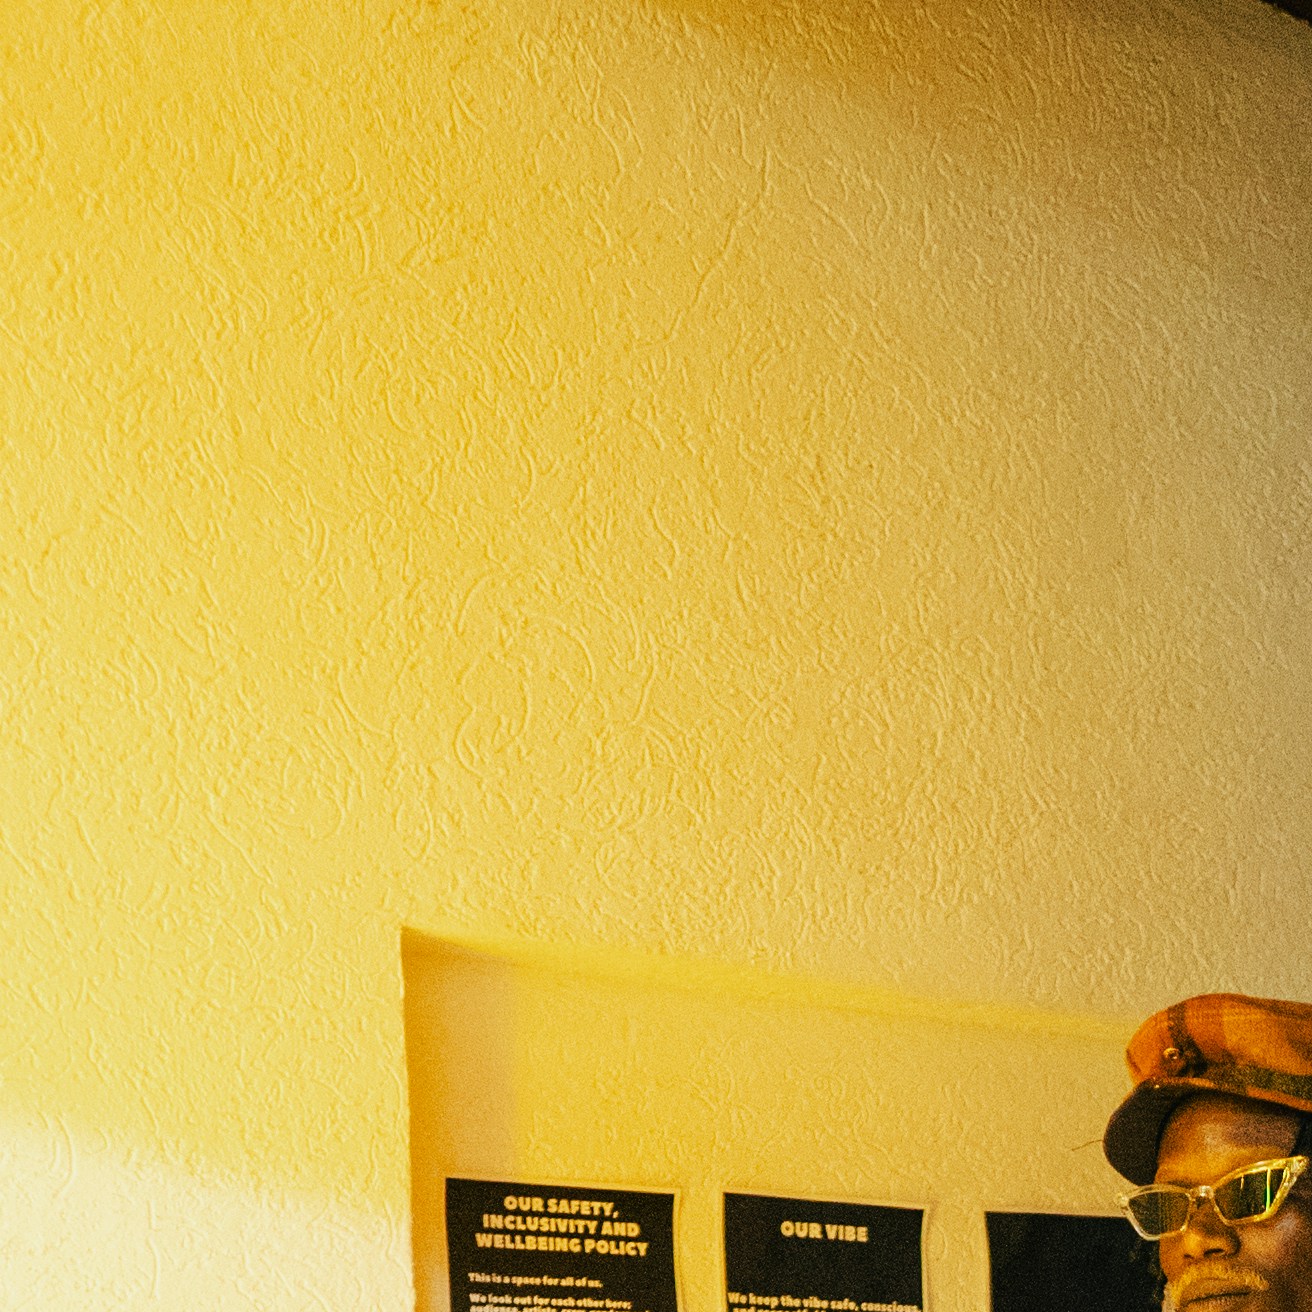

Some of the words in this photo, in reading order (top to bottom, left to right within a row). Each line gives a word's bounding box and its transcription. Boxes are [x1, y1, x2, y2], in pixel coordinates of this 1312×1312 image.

[503, 1196, 544, 1211] OUR
[547, 1198, 618, 1218] SAFETY,
[482, 1214, 598, 1233] INCLUSIVITY
[600, 1221, 640, 1237] AND
[780, 1221, 822, 1238] OUR
[825, 1224, 867, 1242] VIBE
[475, 1233, 581, 1252] WELLBEING
[584, 1239, 648, 1256] POLICY
